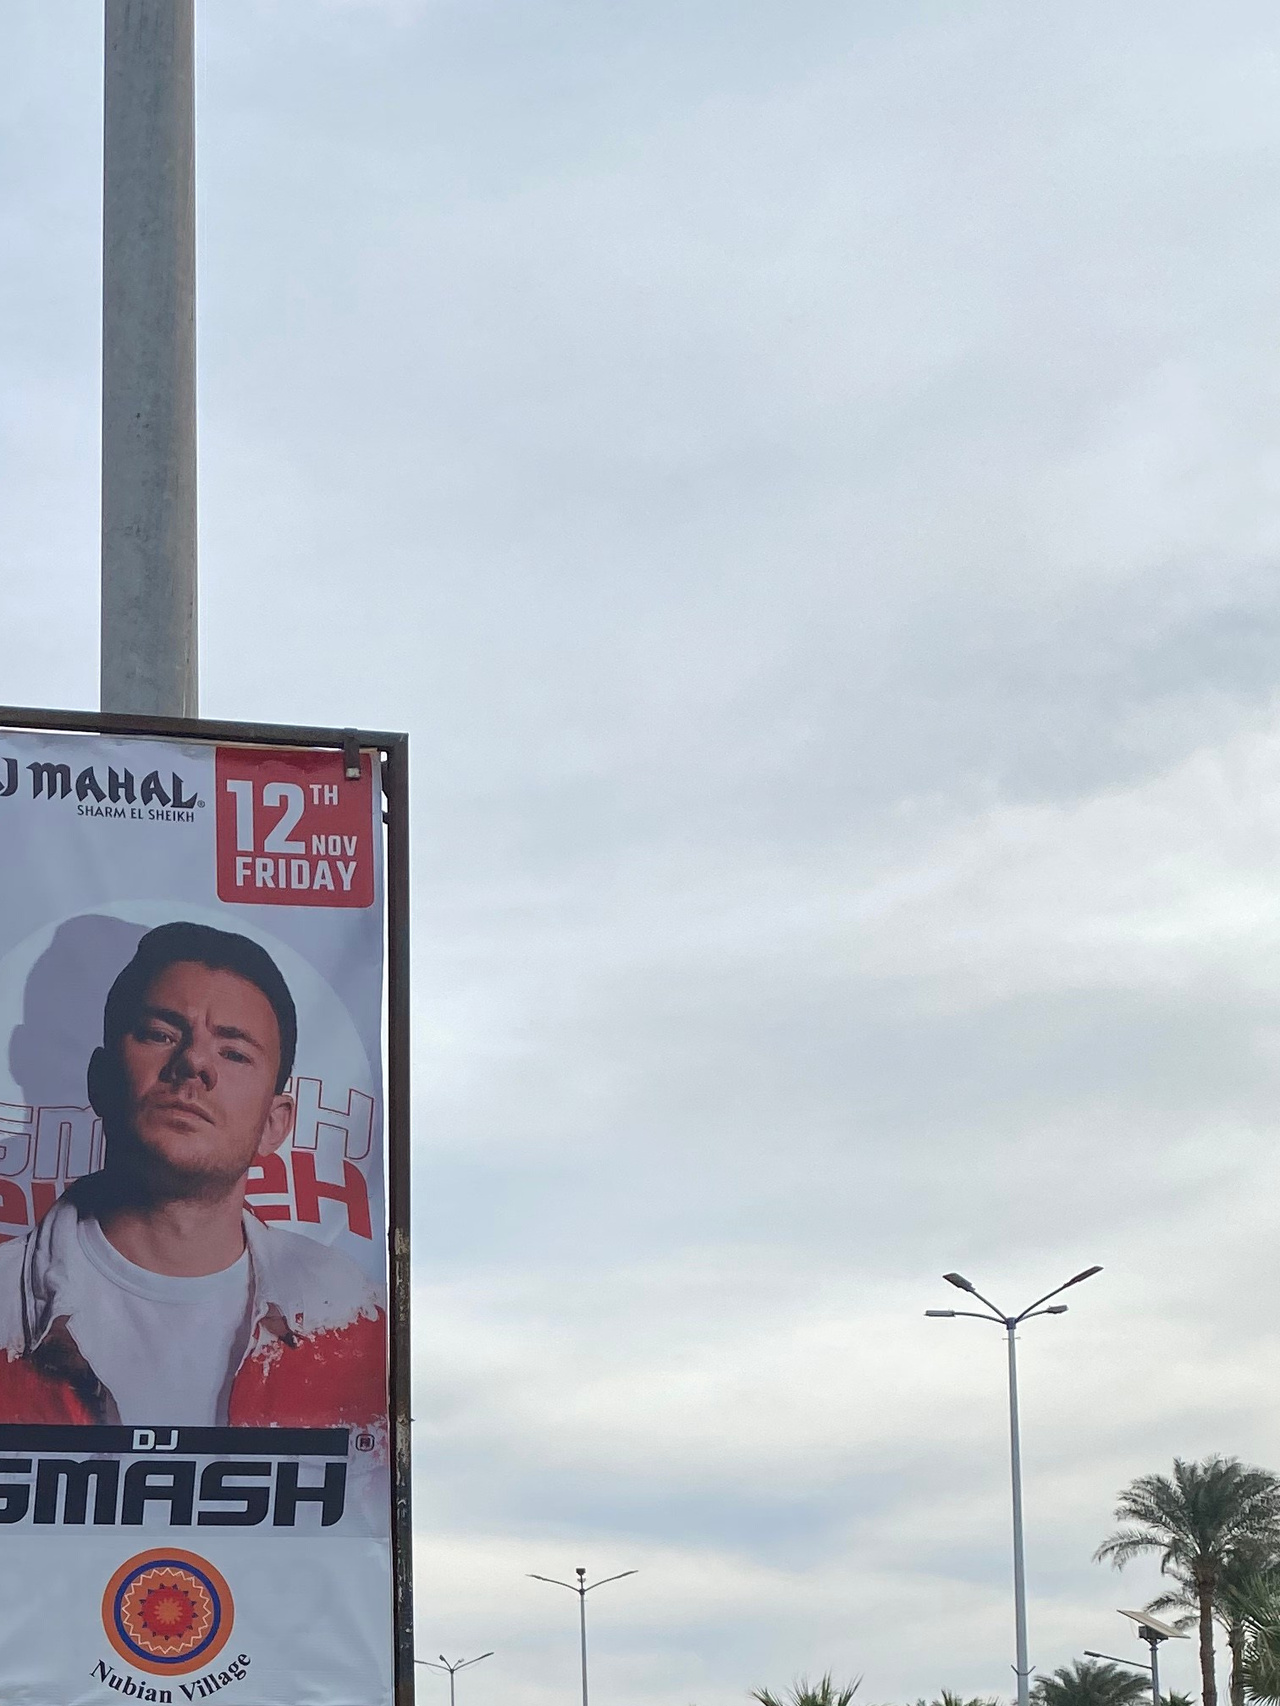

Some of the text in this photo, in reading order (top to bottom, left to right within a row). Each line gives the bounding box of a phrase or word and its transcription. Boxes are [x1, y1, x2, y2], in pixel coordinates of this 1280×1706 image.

[26, 761, 199, 809] MAHAL
[76, 804, 195, 823] SHARM EL SHEIKH
[226, 779, 339, 855] 12 TH
[311, 834, 358, 857] NOV
[235, 856, 358, 892] FRIDAY
[131, 1428, 179, 1451] DJ
[88, 1653, 252, 1704] Nubian Village
